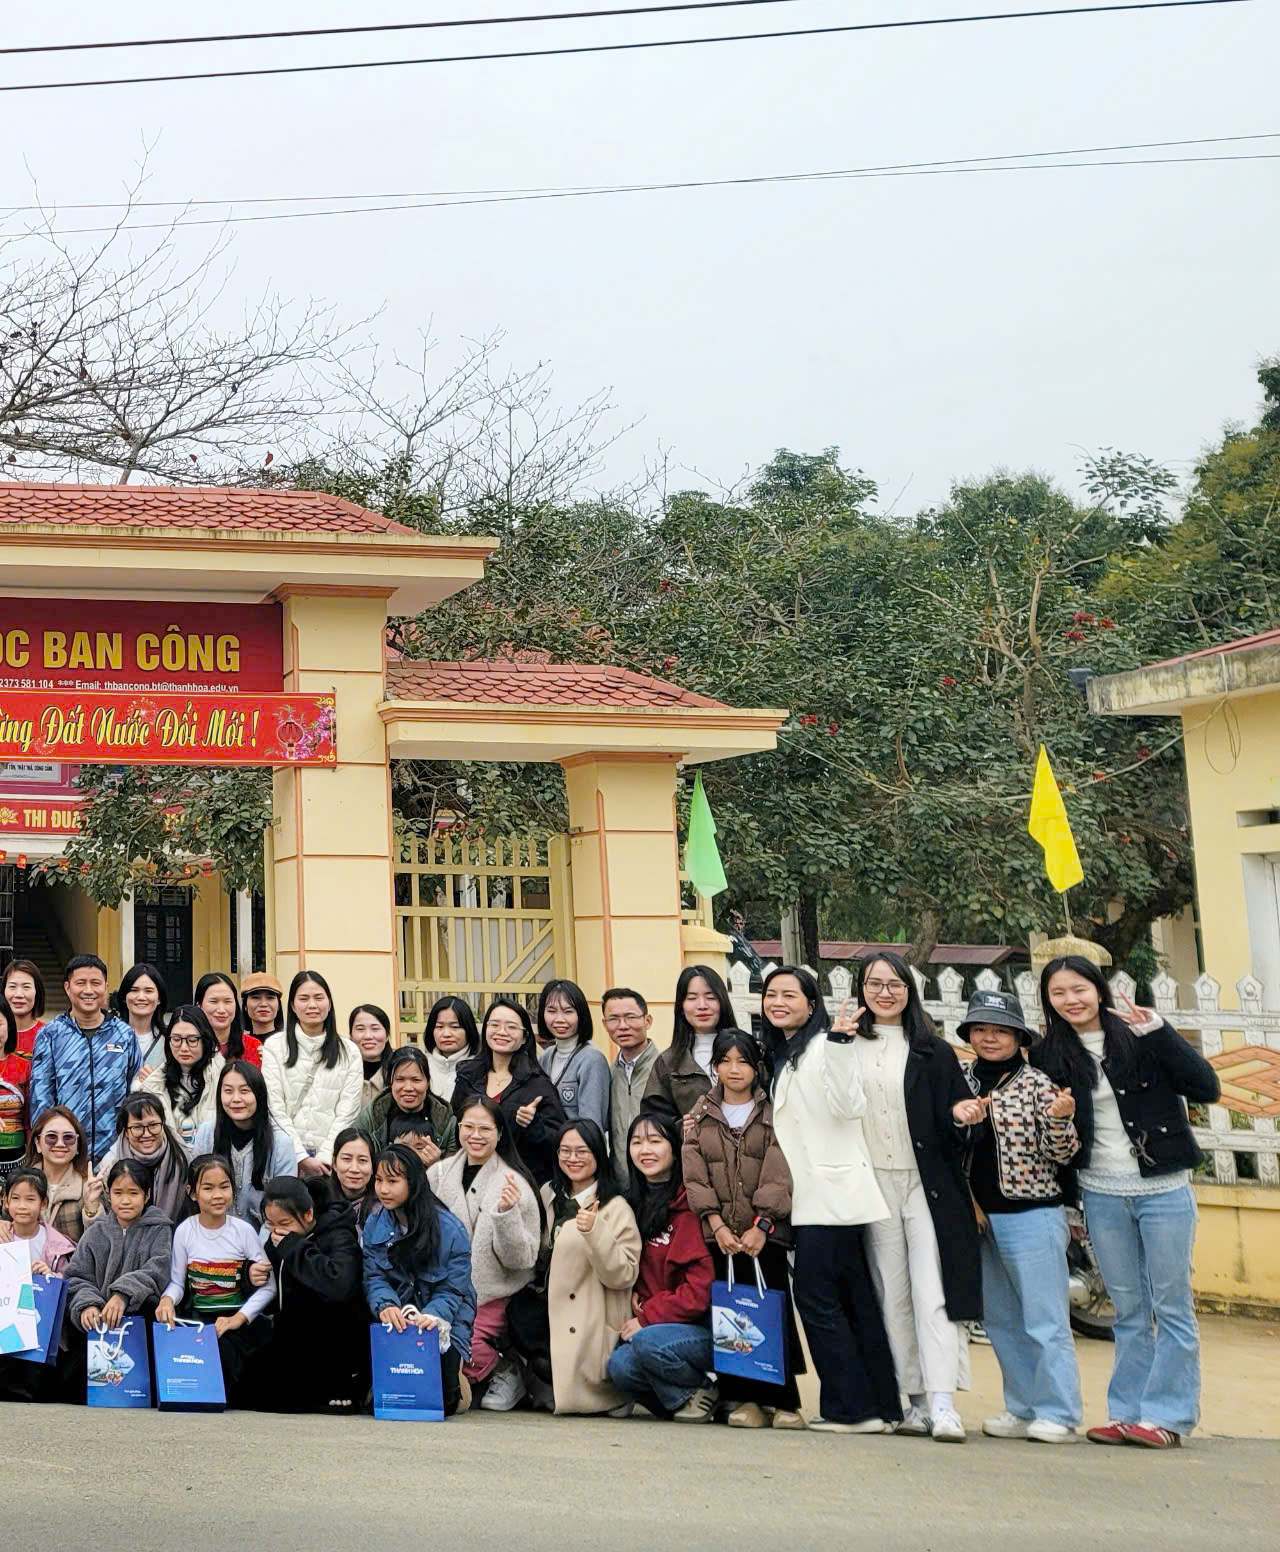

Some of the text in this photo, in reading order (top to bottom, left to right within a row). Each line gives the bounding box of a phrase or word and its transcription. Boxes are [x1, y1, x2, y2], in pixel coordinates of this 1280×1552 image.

[43, 631, 122, 670] BAN
[136, 624, 240, 672] CÔNG
[21, 678, 36, 688] 581
[38, 680, 54, 688] 104
[75, 680, 100, 690] Email:
[40, 704, 86, 746] Đất
[90, 706, 150, 746] Nước
[156, 700, 197, 747] Đổi
[202, 709, 245, 748] Mới
[24, 809, 46, 828] THI
[51, 810, 82, 829] ĐUA
